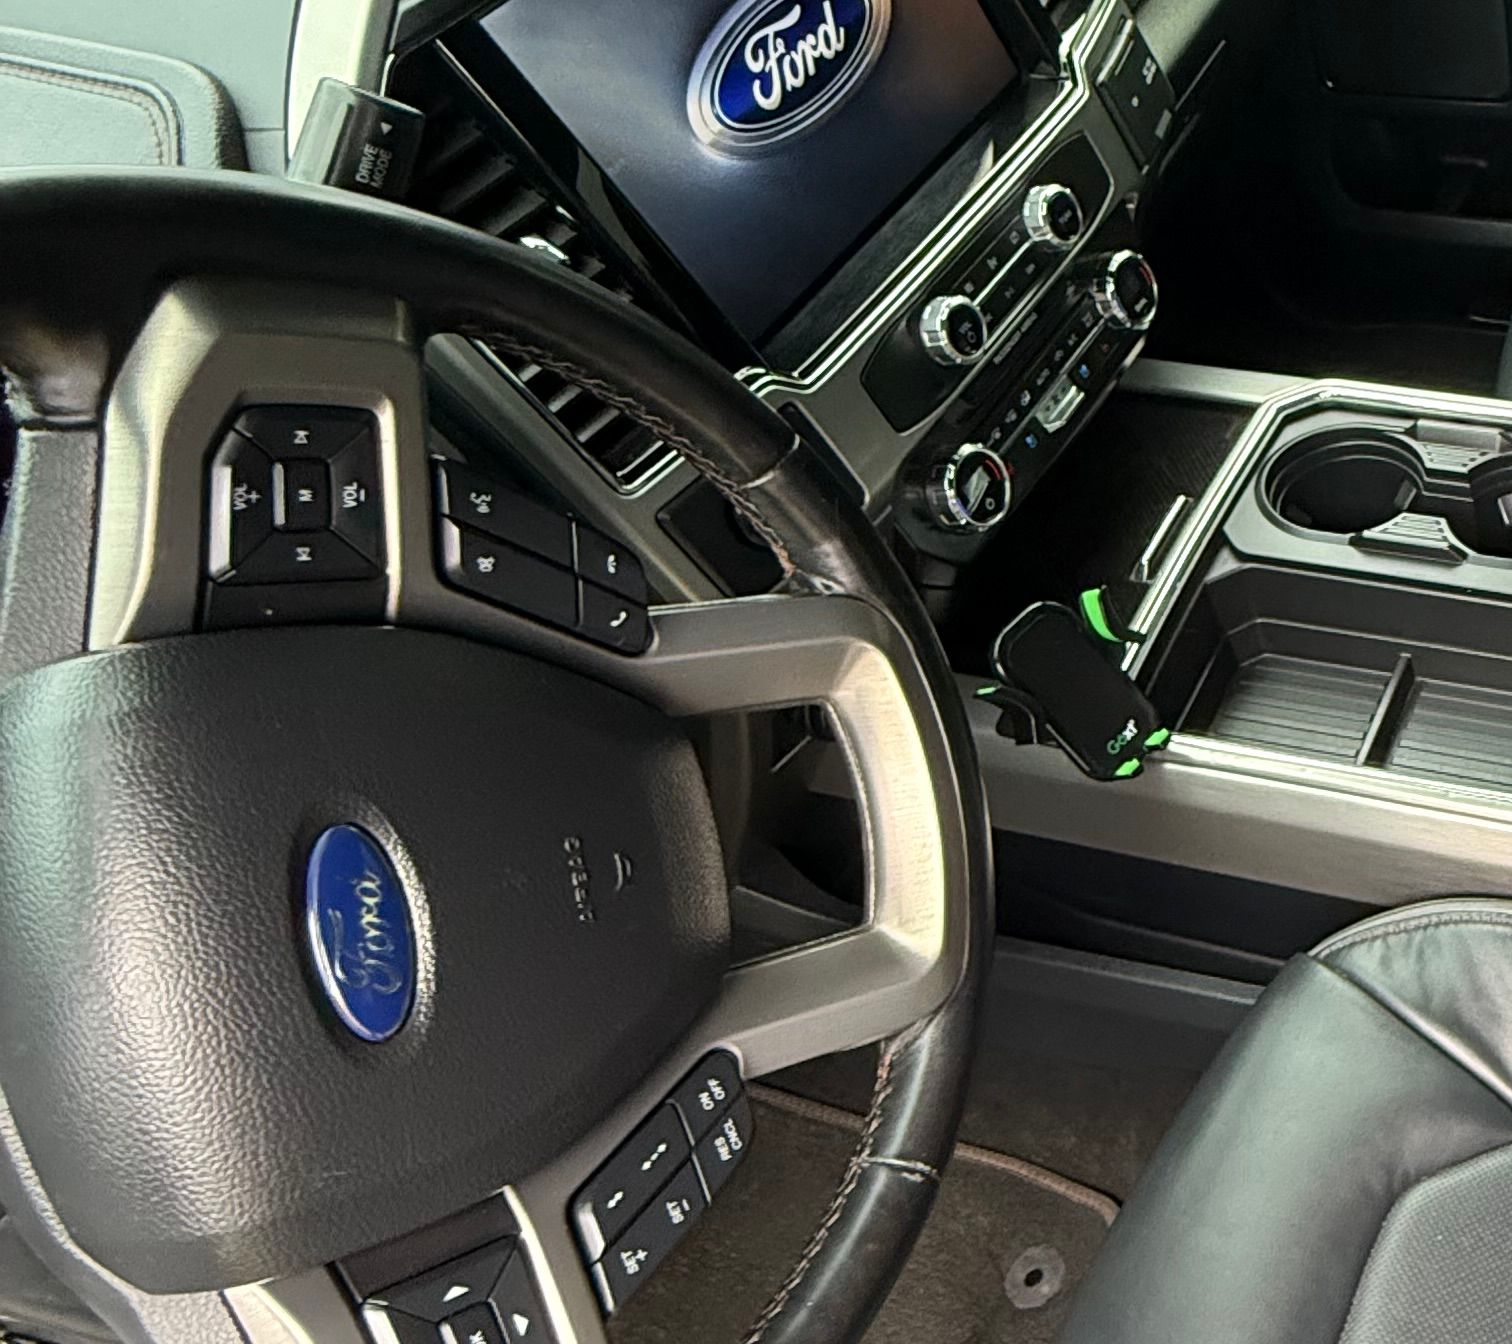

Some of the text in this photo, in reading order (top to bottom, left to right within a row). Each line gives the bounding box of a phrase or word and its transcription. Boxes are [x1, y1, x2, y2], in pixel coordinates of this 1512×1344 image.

[744, 0, 846, 110] Ford
[355, 143, 380, 184] DRIVE
[370, 148, 393, 189] MODE
[233, 483, 248, 511] VOL
[298, 489, 313, 502] M
[342, 482, 358, 508] VOL
[327, 869, 402, 995] Ford
[698, 1091, 715, 1111] ON
[707, 1077, 726, 1101] OFF
[723, 1117, 743, 1152] CNCL
[714, 1136, 733, 1162] RES
[665, 1200, 685, 1225] SET
[620, 1250, 640, 1275] SET
